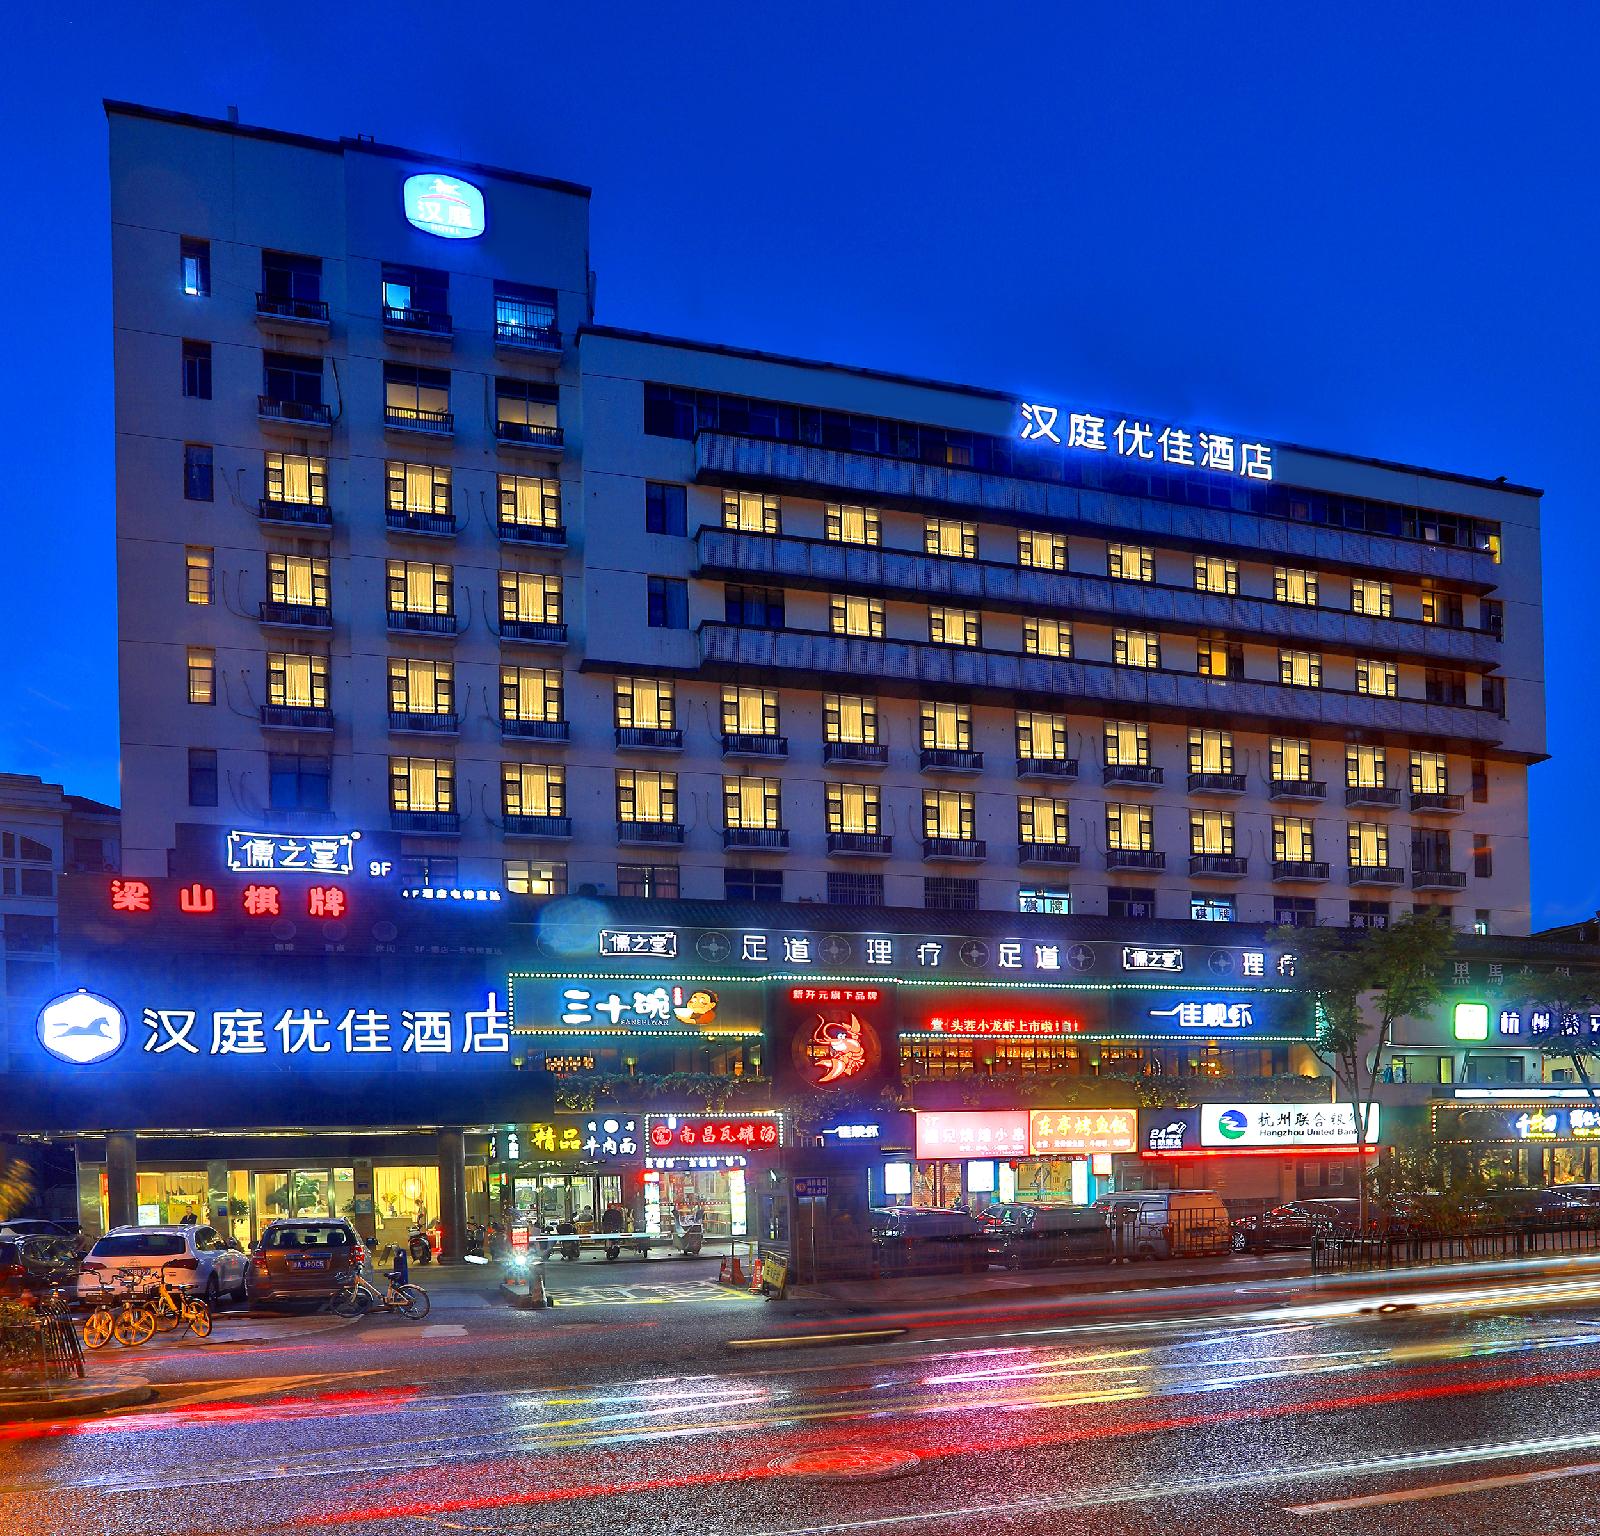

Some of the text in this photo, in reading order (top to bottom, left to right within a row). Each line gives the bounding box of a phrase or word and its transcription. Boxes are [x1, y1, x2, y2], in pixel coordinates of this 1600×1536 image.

[1020, 402, 1273, 480] 汉庭优佳酒店
[240, 838, 340, 870] 儒之堂
[369, 862, 392, 877] 9F
[111, 879, 345, 917] 梁山棋牌
[1024, 899, 1064, 914] 棋牌
[608, 934, 669, 953] 儒之堂
[741, 935, 812, 963] 足道
[866, 939, 943, 966] 理疗
[998, 943, 1061, 970] 足道
[561, 987, 671, 1024] 三十碗
[792, 989, 878, 1000] 新开元旗下品牌
[143, 992, 510, 1054] 汉庭优佳酒店
[1150, 1002, 1253, 1028] 一佳靓虾
[531, 1125, 582, 1152] 精品
[679, 1125, 777, 1145] 南昌瓦罐汤
[1259, 1127, 1357, 1137] Hangzhou United Bank
[582, 1135, 637, 1156] 牛肉面
